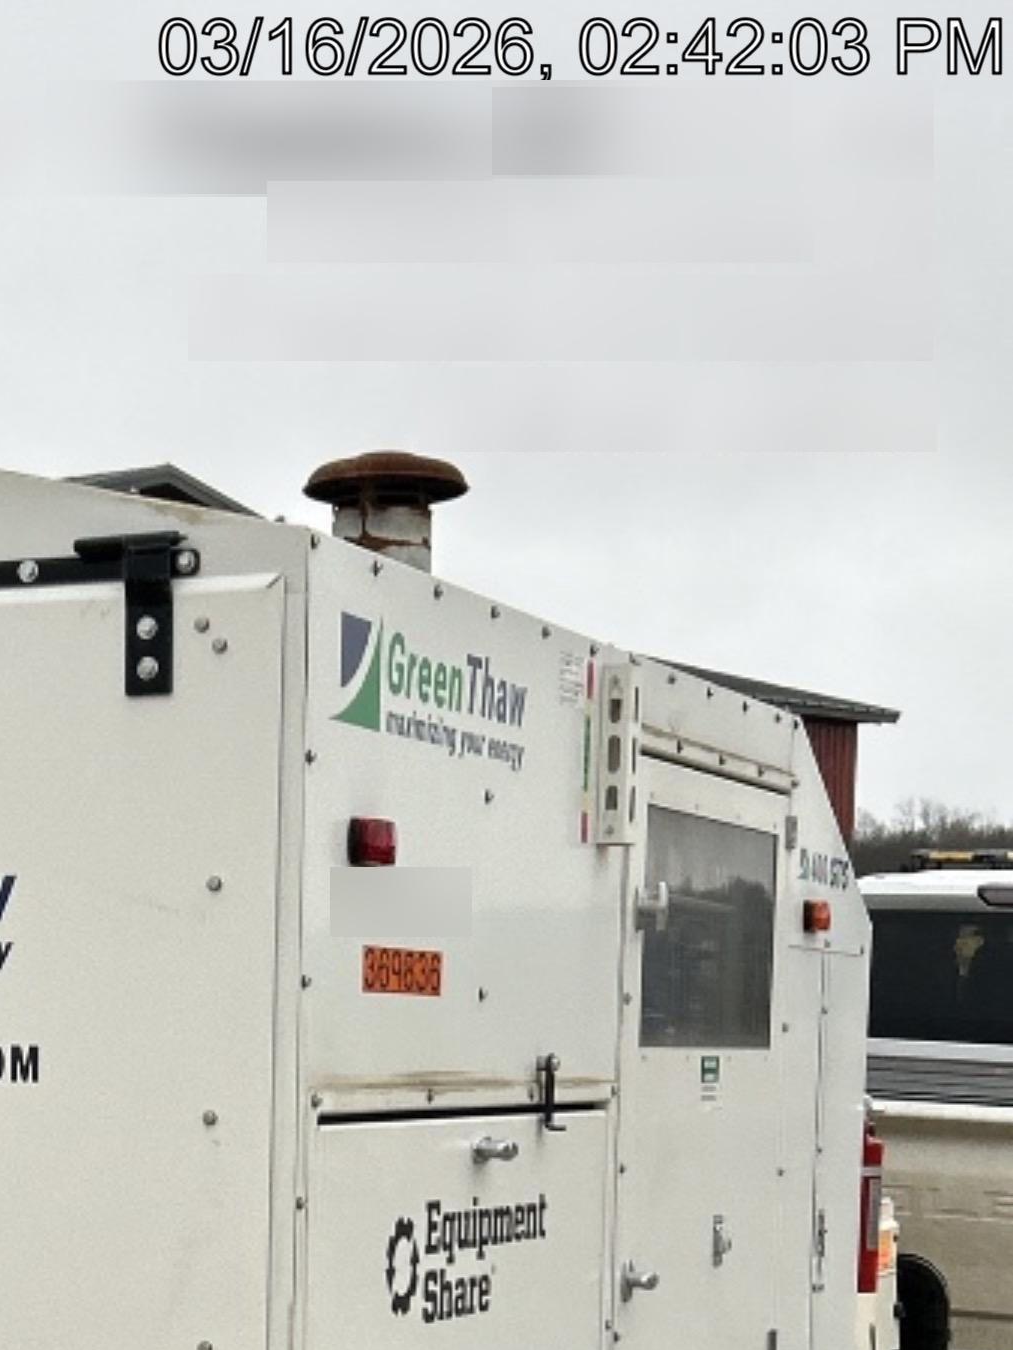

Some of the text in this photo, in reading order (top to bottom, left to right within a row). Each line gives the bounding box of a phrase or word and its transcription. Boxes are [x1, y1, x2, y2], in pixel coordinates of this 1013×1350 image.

[458, 732, 486, 758] your
[365, 947, 440, 991] 369836
[424, 1193, 548, 1265] Equipment
[422, 1268, 492, 1323] Share
